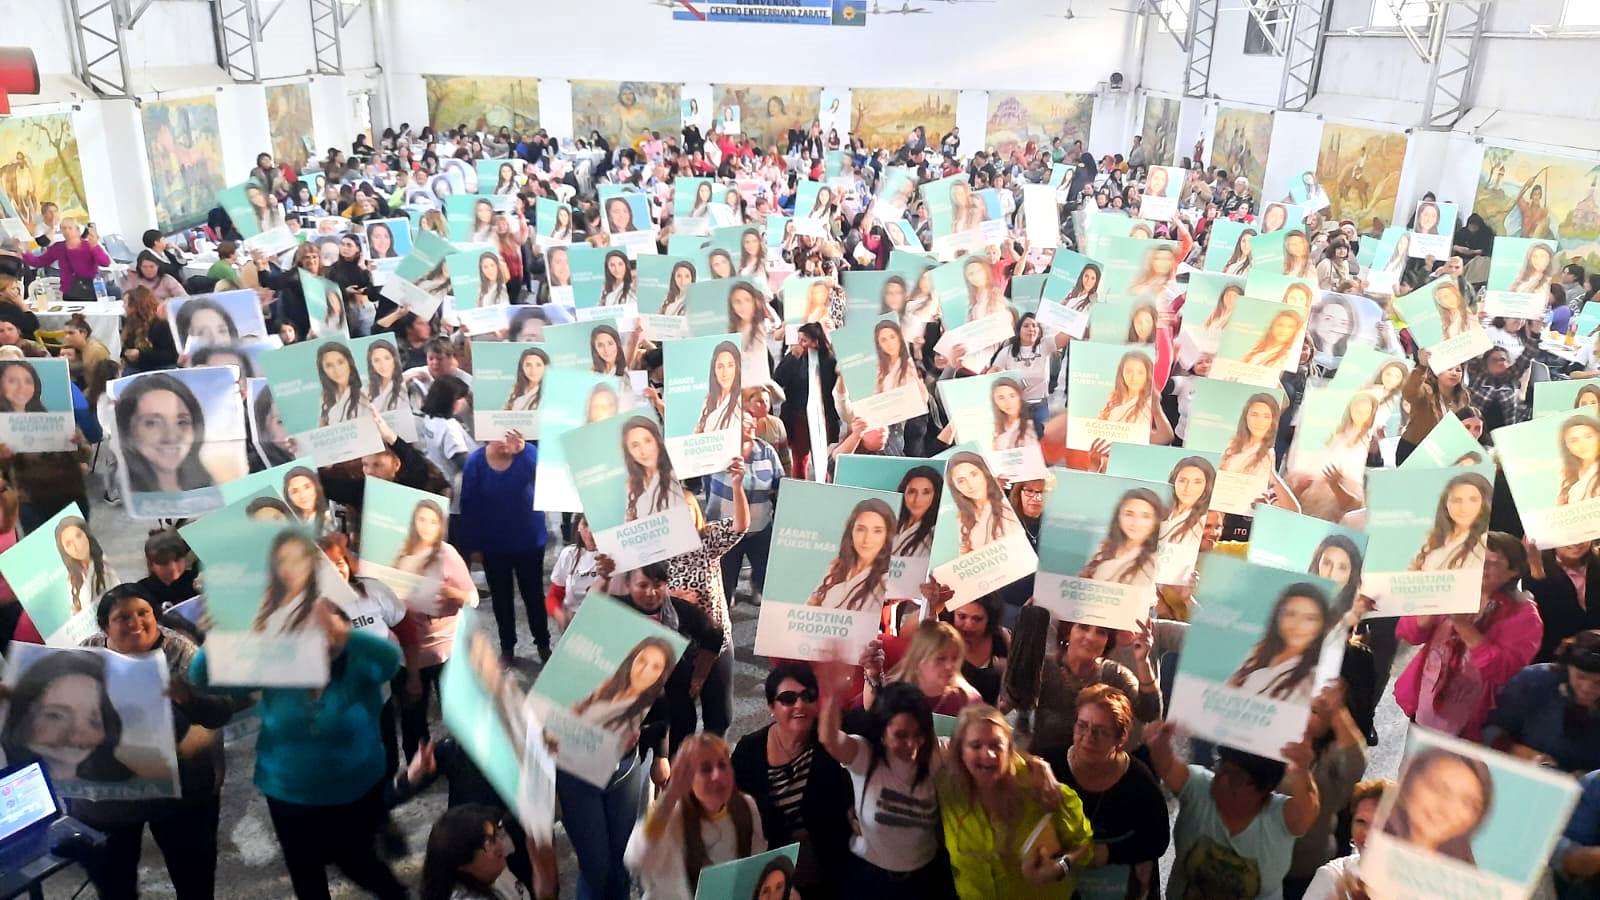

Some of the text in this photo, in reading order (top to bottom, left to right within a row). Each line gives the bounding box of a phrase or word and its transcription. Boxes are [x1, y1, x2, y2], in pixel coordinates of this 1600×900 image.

[709, 6, 742, 16] CENTRO
[616, 515, 669, 540] AGUSTINA
[621, 526, 670, 549] PROPATO
[952, 543, 1006, 573] AGUSTINA
[958, 552, 1009, 580] PROPATO
[1060, 579, 1124, 597] AGUSTINA
[1061, 589, 1121, 606] PROPATO
[352, 615, 375, 628] Ella
[787, 608, 853, 625] AGUSTINA
[788, 621, 849, 637] PROPATO
